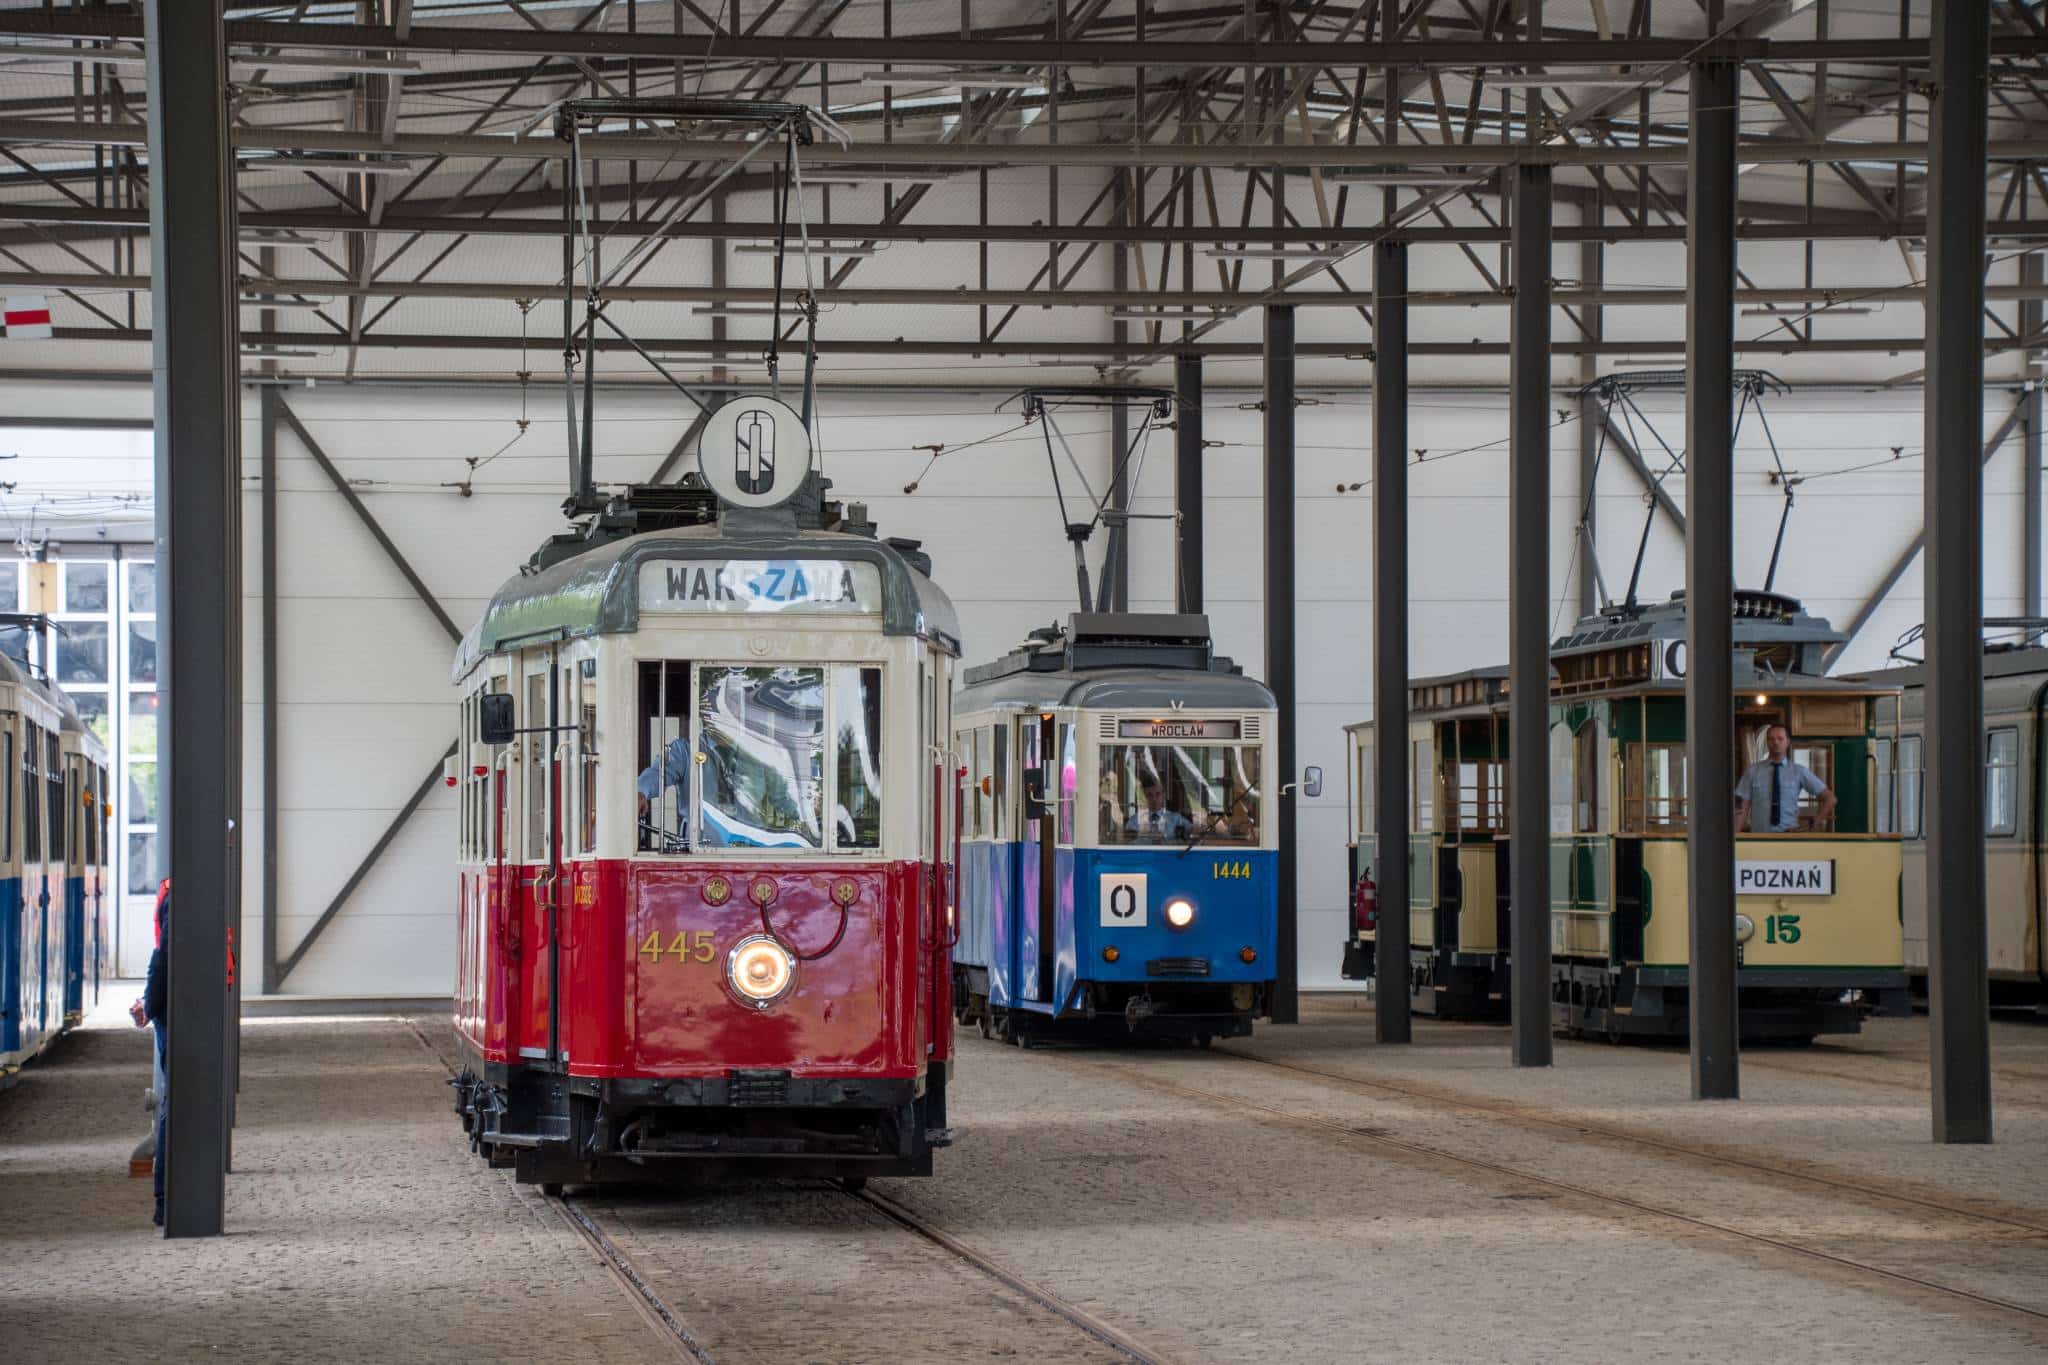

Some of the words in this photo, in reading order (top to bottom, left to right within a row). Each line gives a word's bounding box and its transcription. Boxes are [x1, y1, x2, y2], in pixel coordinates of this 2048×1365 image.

[1213, 861, 1251, 880] 1444
[1740, 865, 1821, 888] POZNAŃ
[1765, 914, 1802, 944] 15
[640, 930, 716, 964] 445
